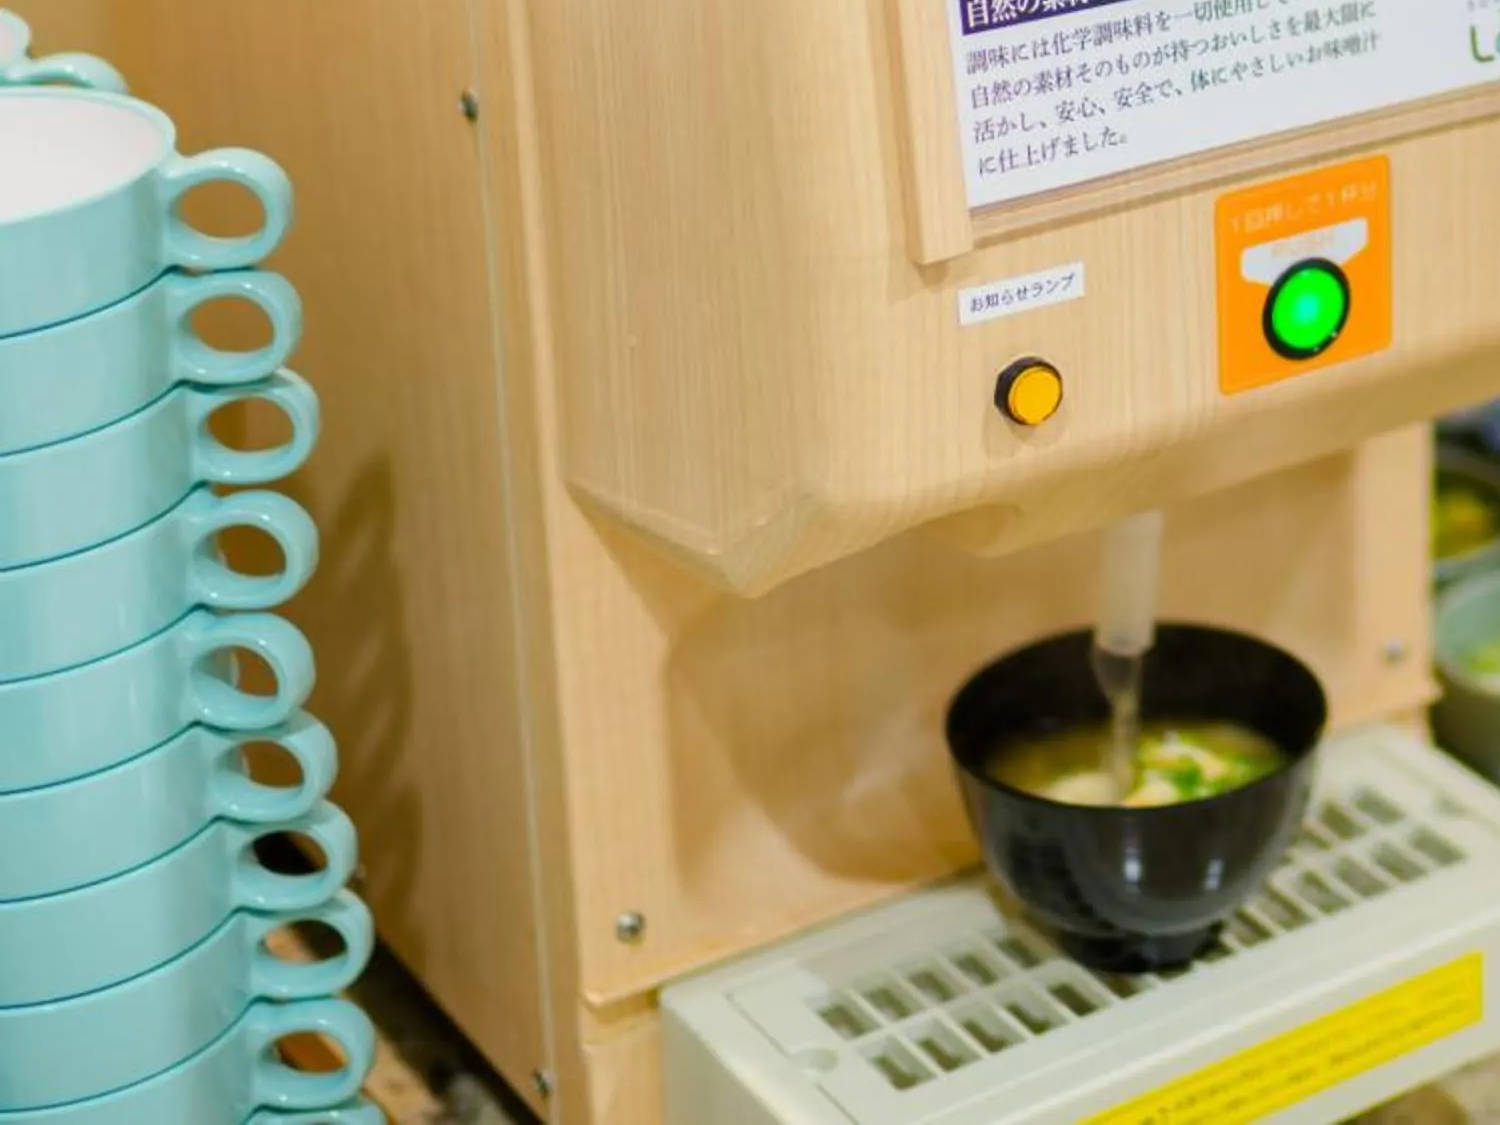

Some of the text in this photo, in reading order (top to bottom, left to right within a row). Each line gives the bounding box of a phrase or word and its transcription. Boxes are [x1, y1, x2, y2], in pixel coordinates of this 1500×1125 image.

[978, 125, 1128, 176] に仕上げました。
